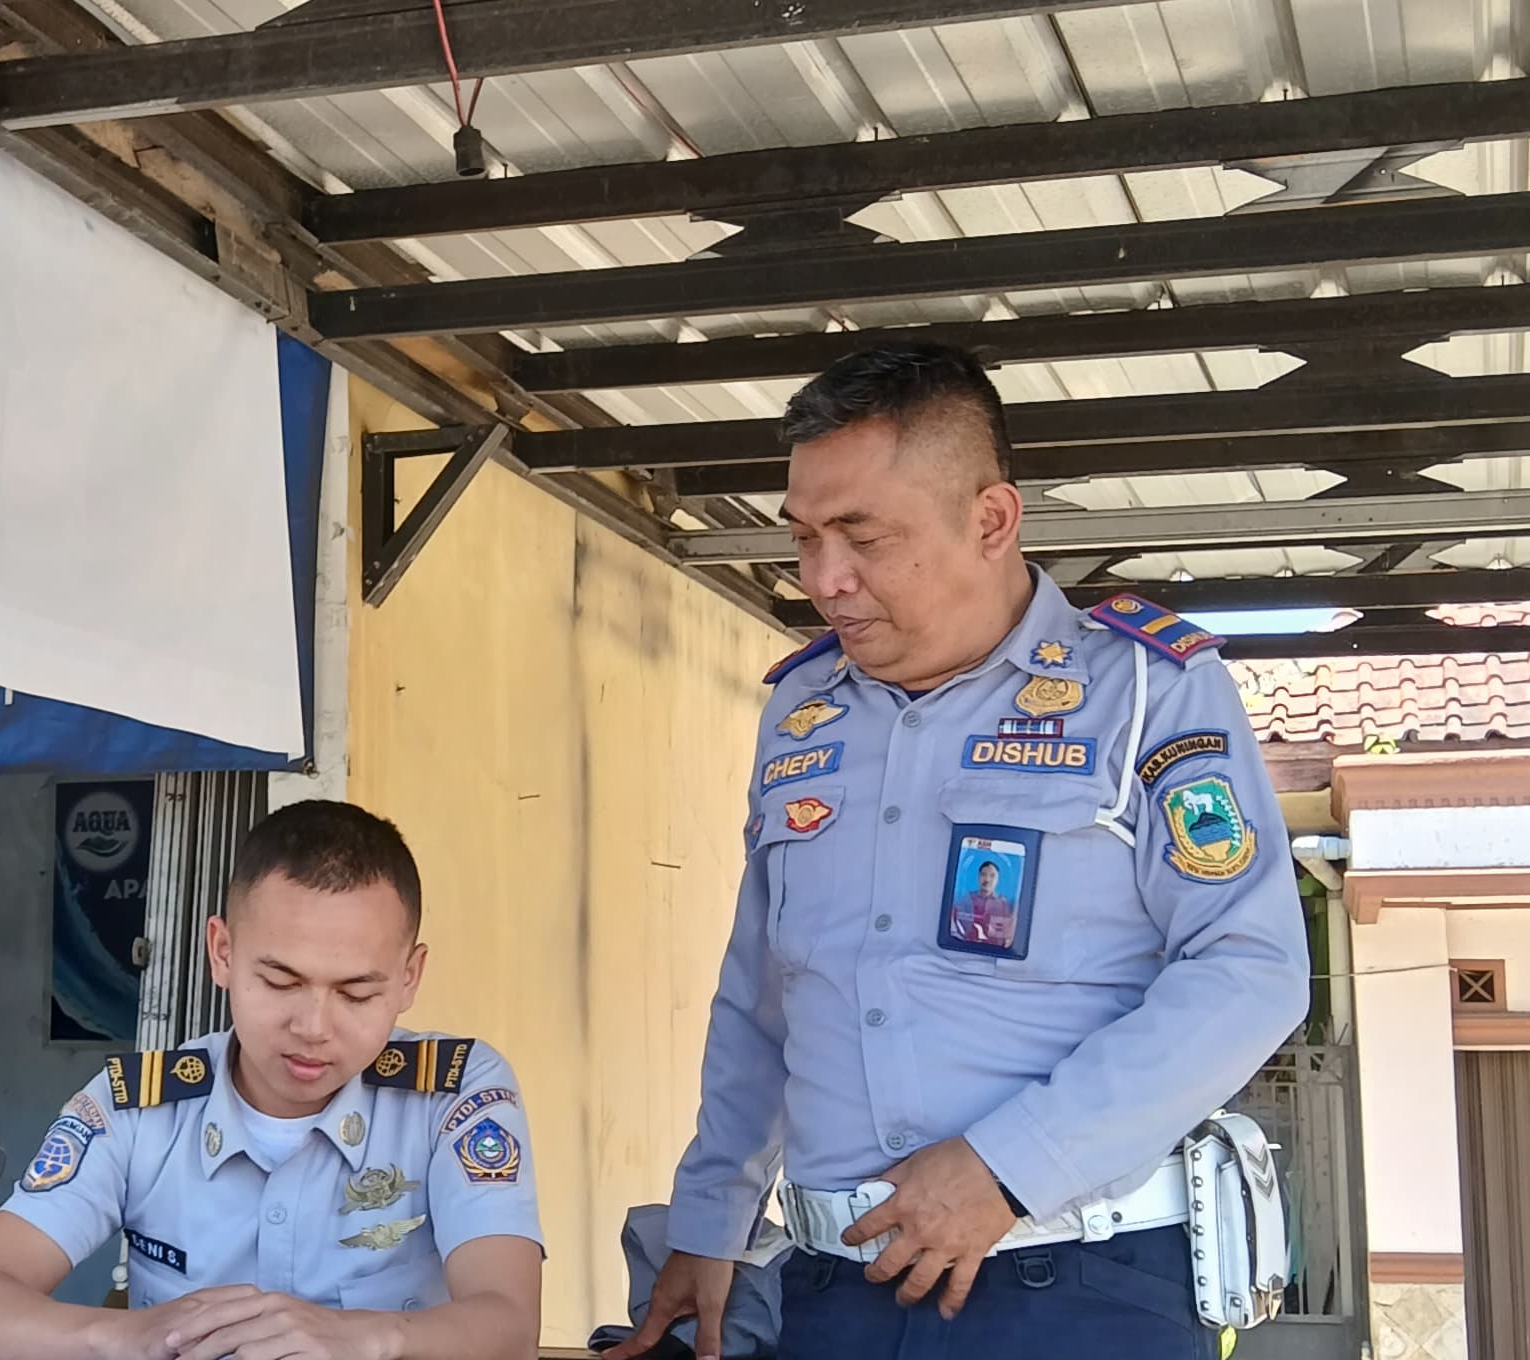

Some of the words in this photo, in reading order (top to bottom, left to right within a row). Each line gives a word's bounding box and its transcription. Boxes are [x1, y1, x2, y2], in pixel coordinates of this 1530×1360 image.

[763, 748, 834, 785] CHEPY
[972, 741, 1087, 767] DISHUB
[72, 810, 131, 835] AQUA
